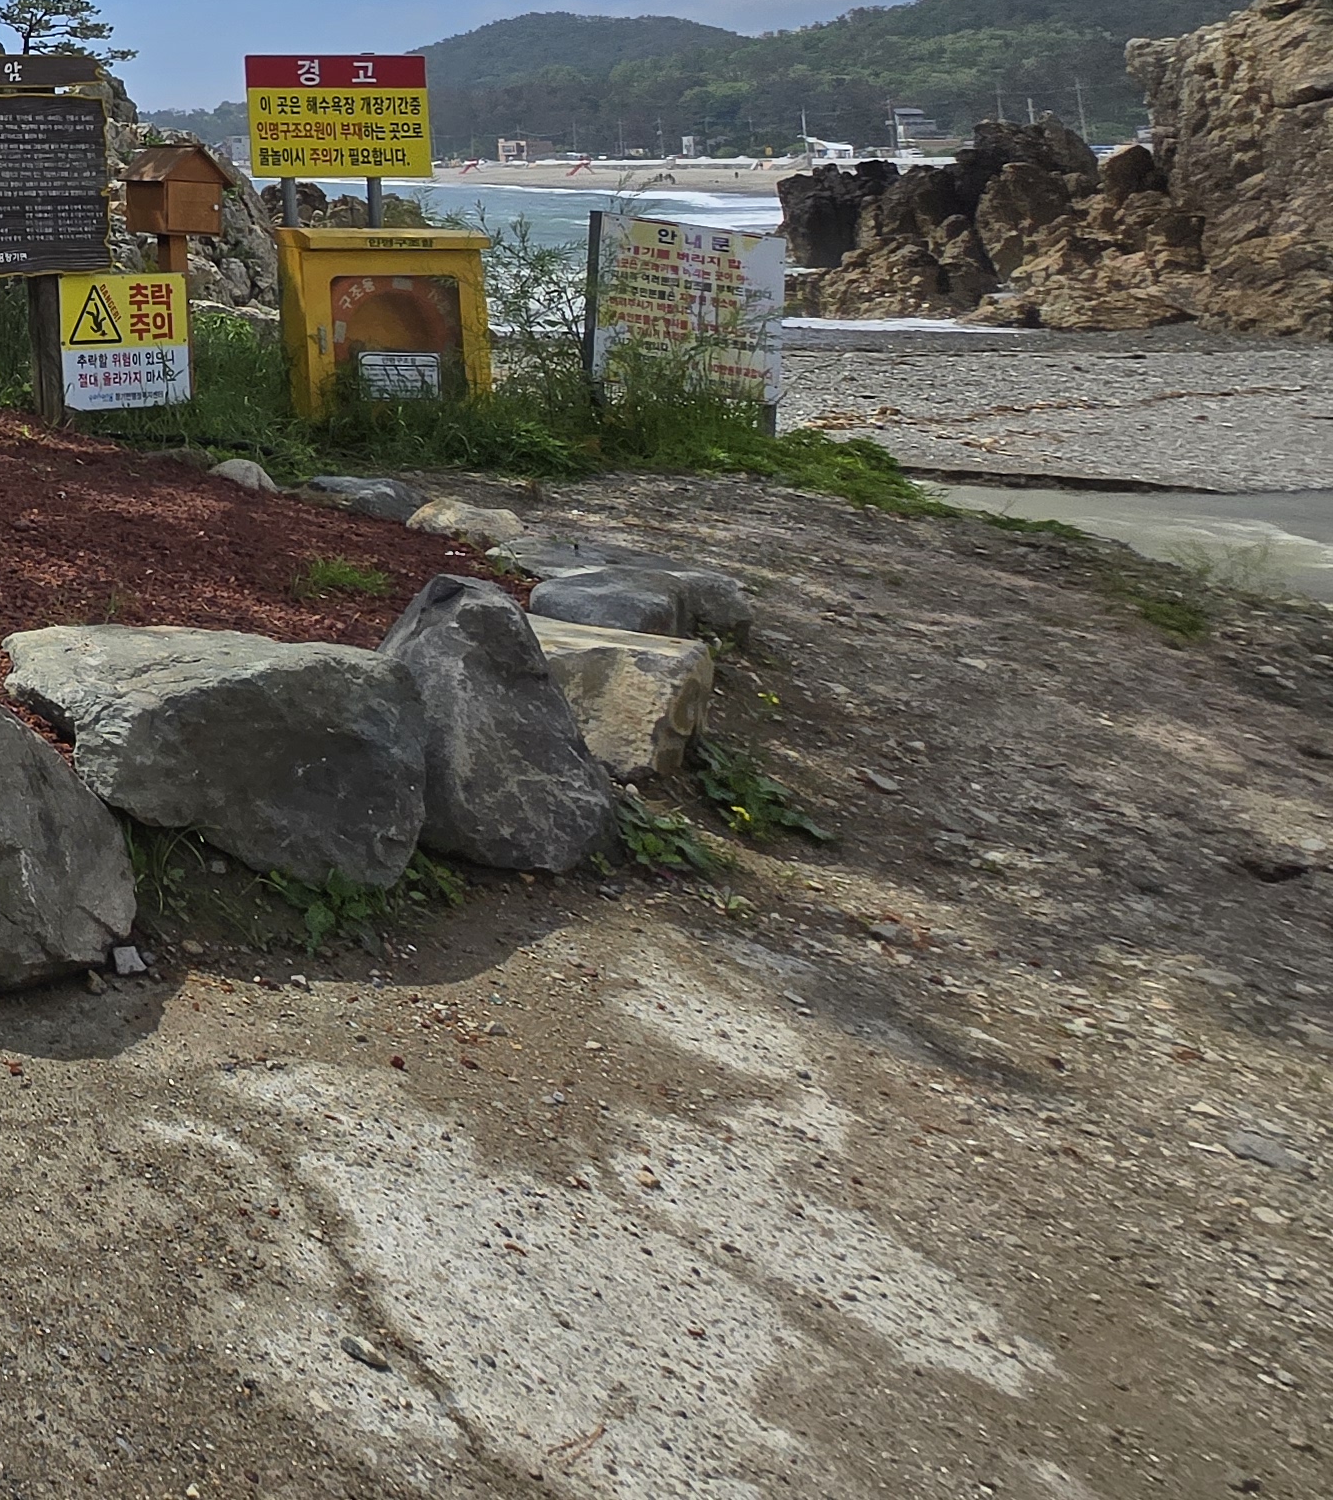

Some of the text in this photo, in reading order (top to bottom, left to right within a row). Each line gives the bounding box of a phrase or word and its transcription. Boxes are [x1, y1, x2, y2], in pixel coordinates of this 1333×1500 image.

[260, 96, 421, 115] 이 곳은 해수욕장 개장기간중
[257, 122, 423, 141] 인명구조요원이 부재하는 곳으로
[259, 148, 411, 167] 물놀이시 주의가 필요합니다.
[129, 283, 173, 311] 추락
[130, 312, 174, 341] 주의
[77, 350, 175, 369] 추락할 위험이 있으니
[78, 373, 98, 388] 절대
[103, 371, 142, 386] 올라가지
